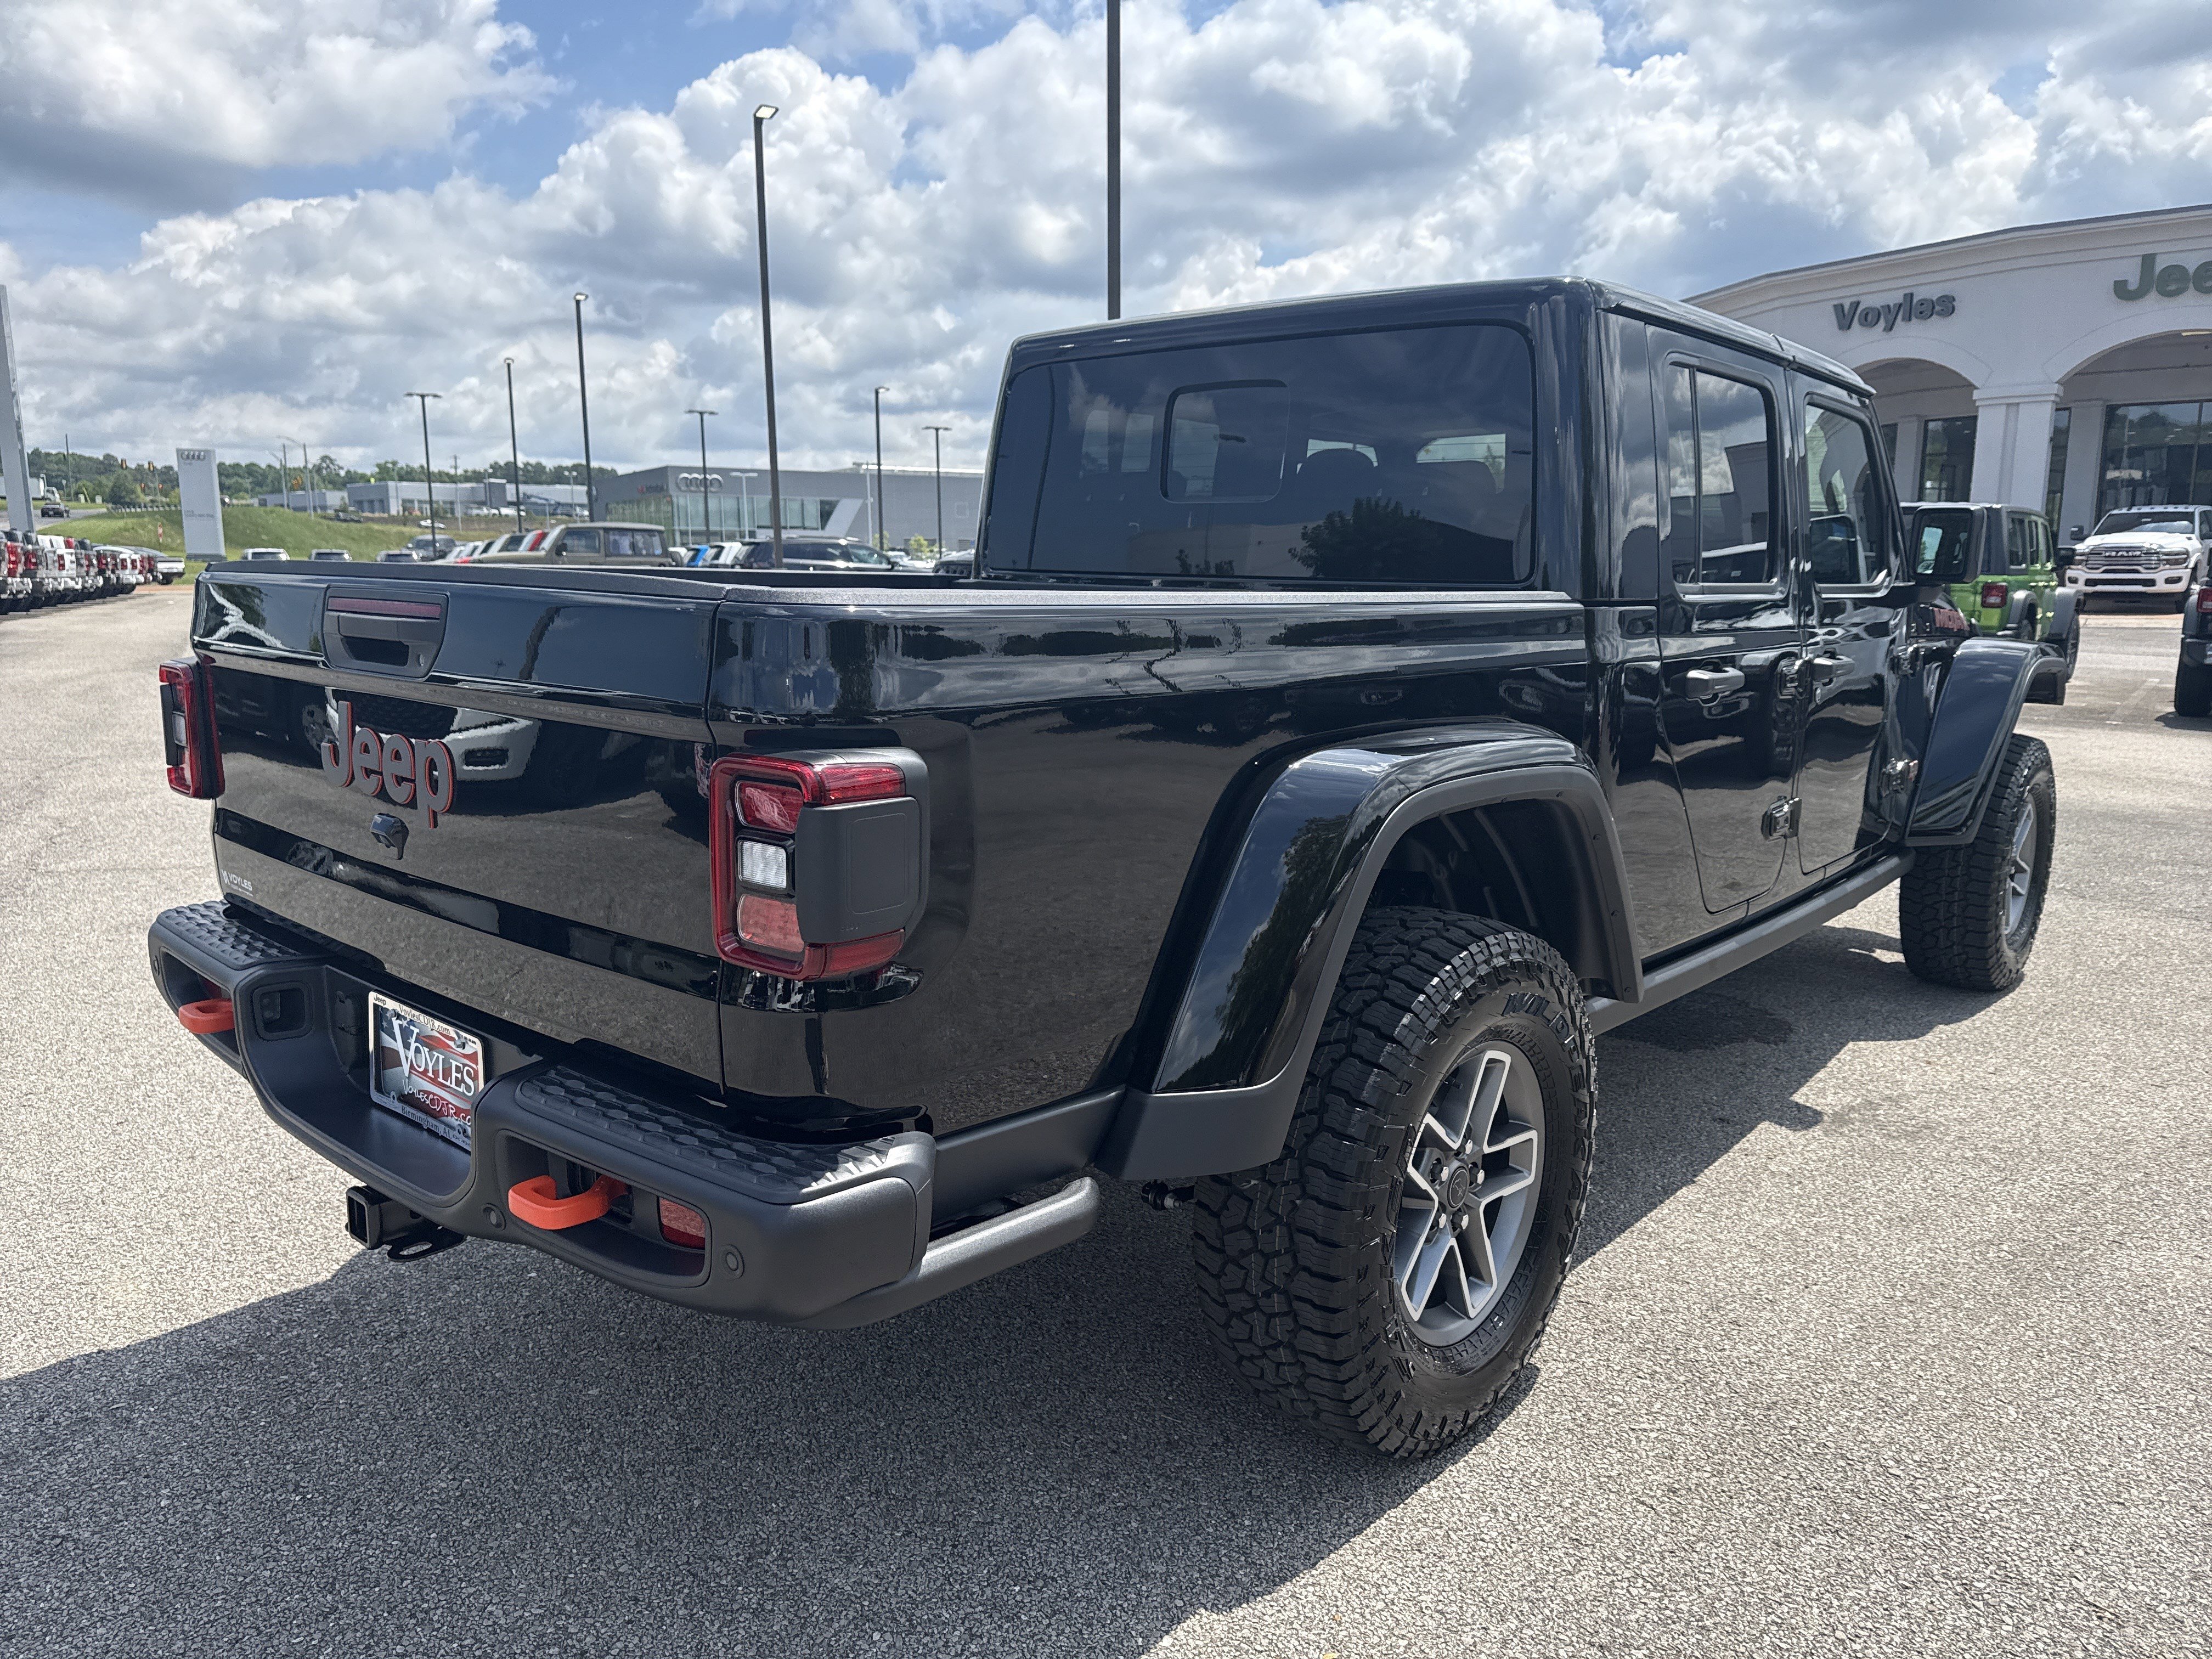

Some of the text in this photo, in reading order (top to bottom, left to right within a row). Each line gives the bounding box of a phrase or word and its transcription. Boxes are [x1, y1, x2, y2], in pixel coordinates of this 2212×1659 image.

[1832, 292, 1956, 332] Voyles
[321, 701, 454, 829] Jeep
[228, 872, 252, 891] VOYLES
[374, 994, 386, 1006] Jeep
[398, 1003, 451, 1035] VoylesCDJR.com
[392, 1017, 475, 1096] VOYLES
[1502, 992, 1587, 1161] WILDPEAK
[401, 1104, 452, 1139] Birmingham, AL
